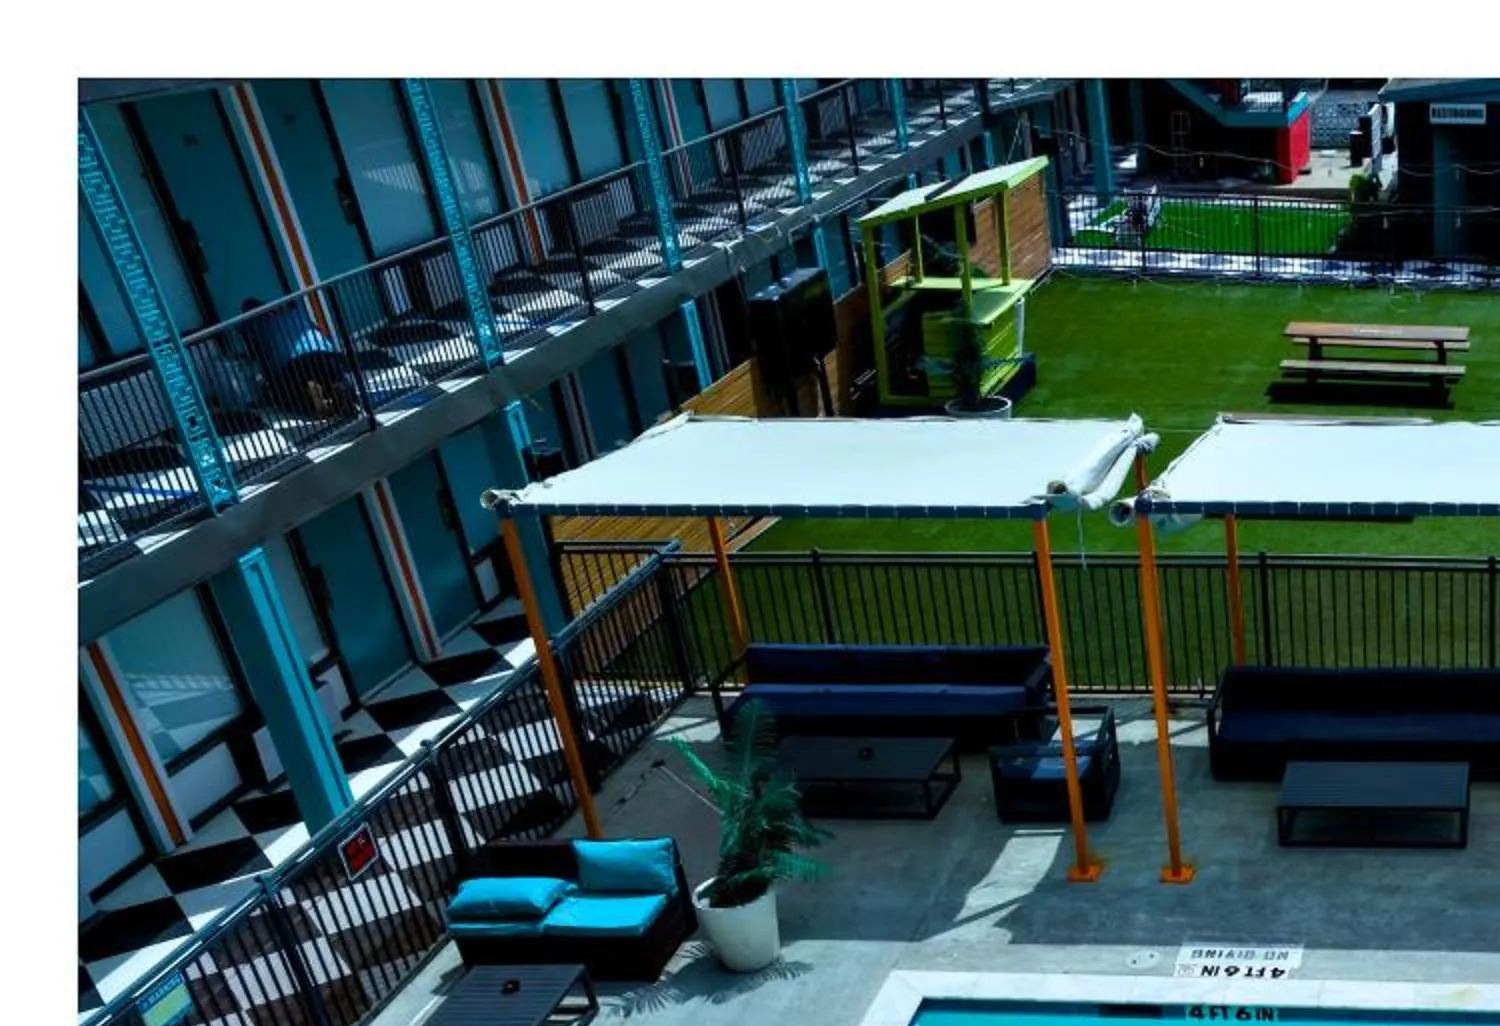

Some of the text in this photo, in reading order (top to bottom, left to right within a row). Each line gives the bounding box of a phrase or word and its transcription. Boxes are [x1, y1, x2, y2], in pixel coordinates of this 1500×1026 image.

[1224, 965, 1241, 977] 6
[1270, 967, 1286, 979] 4
[1236, 1005, 1252, 1021] 6
